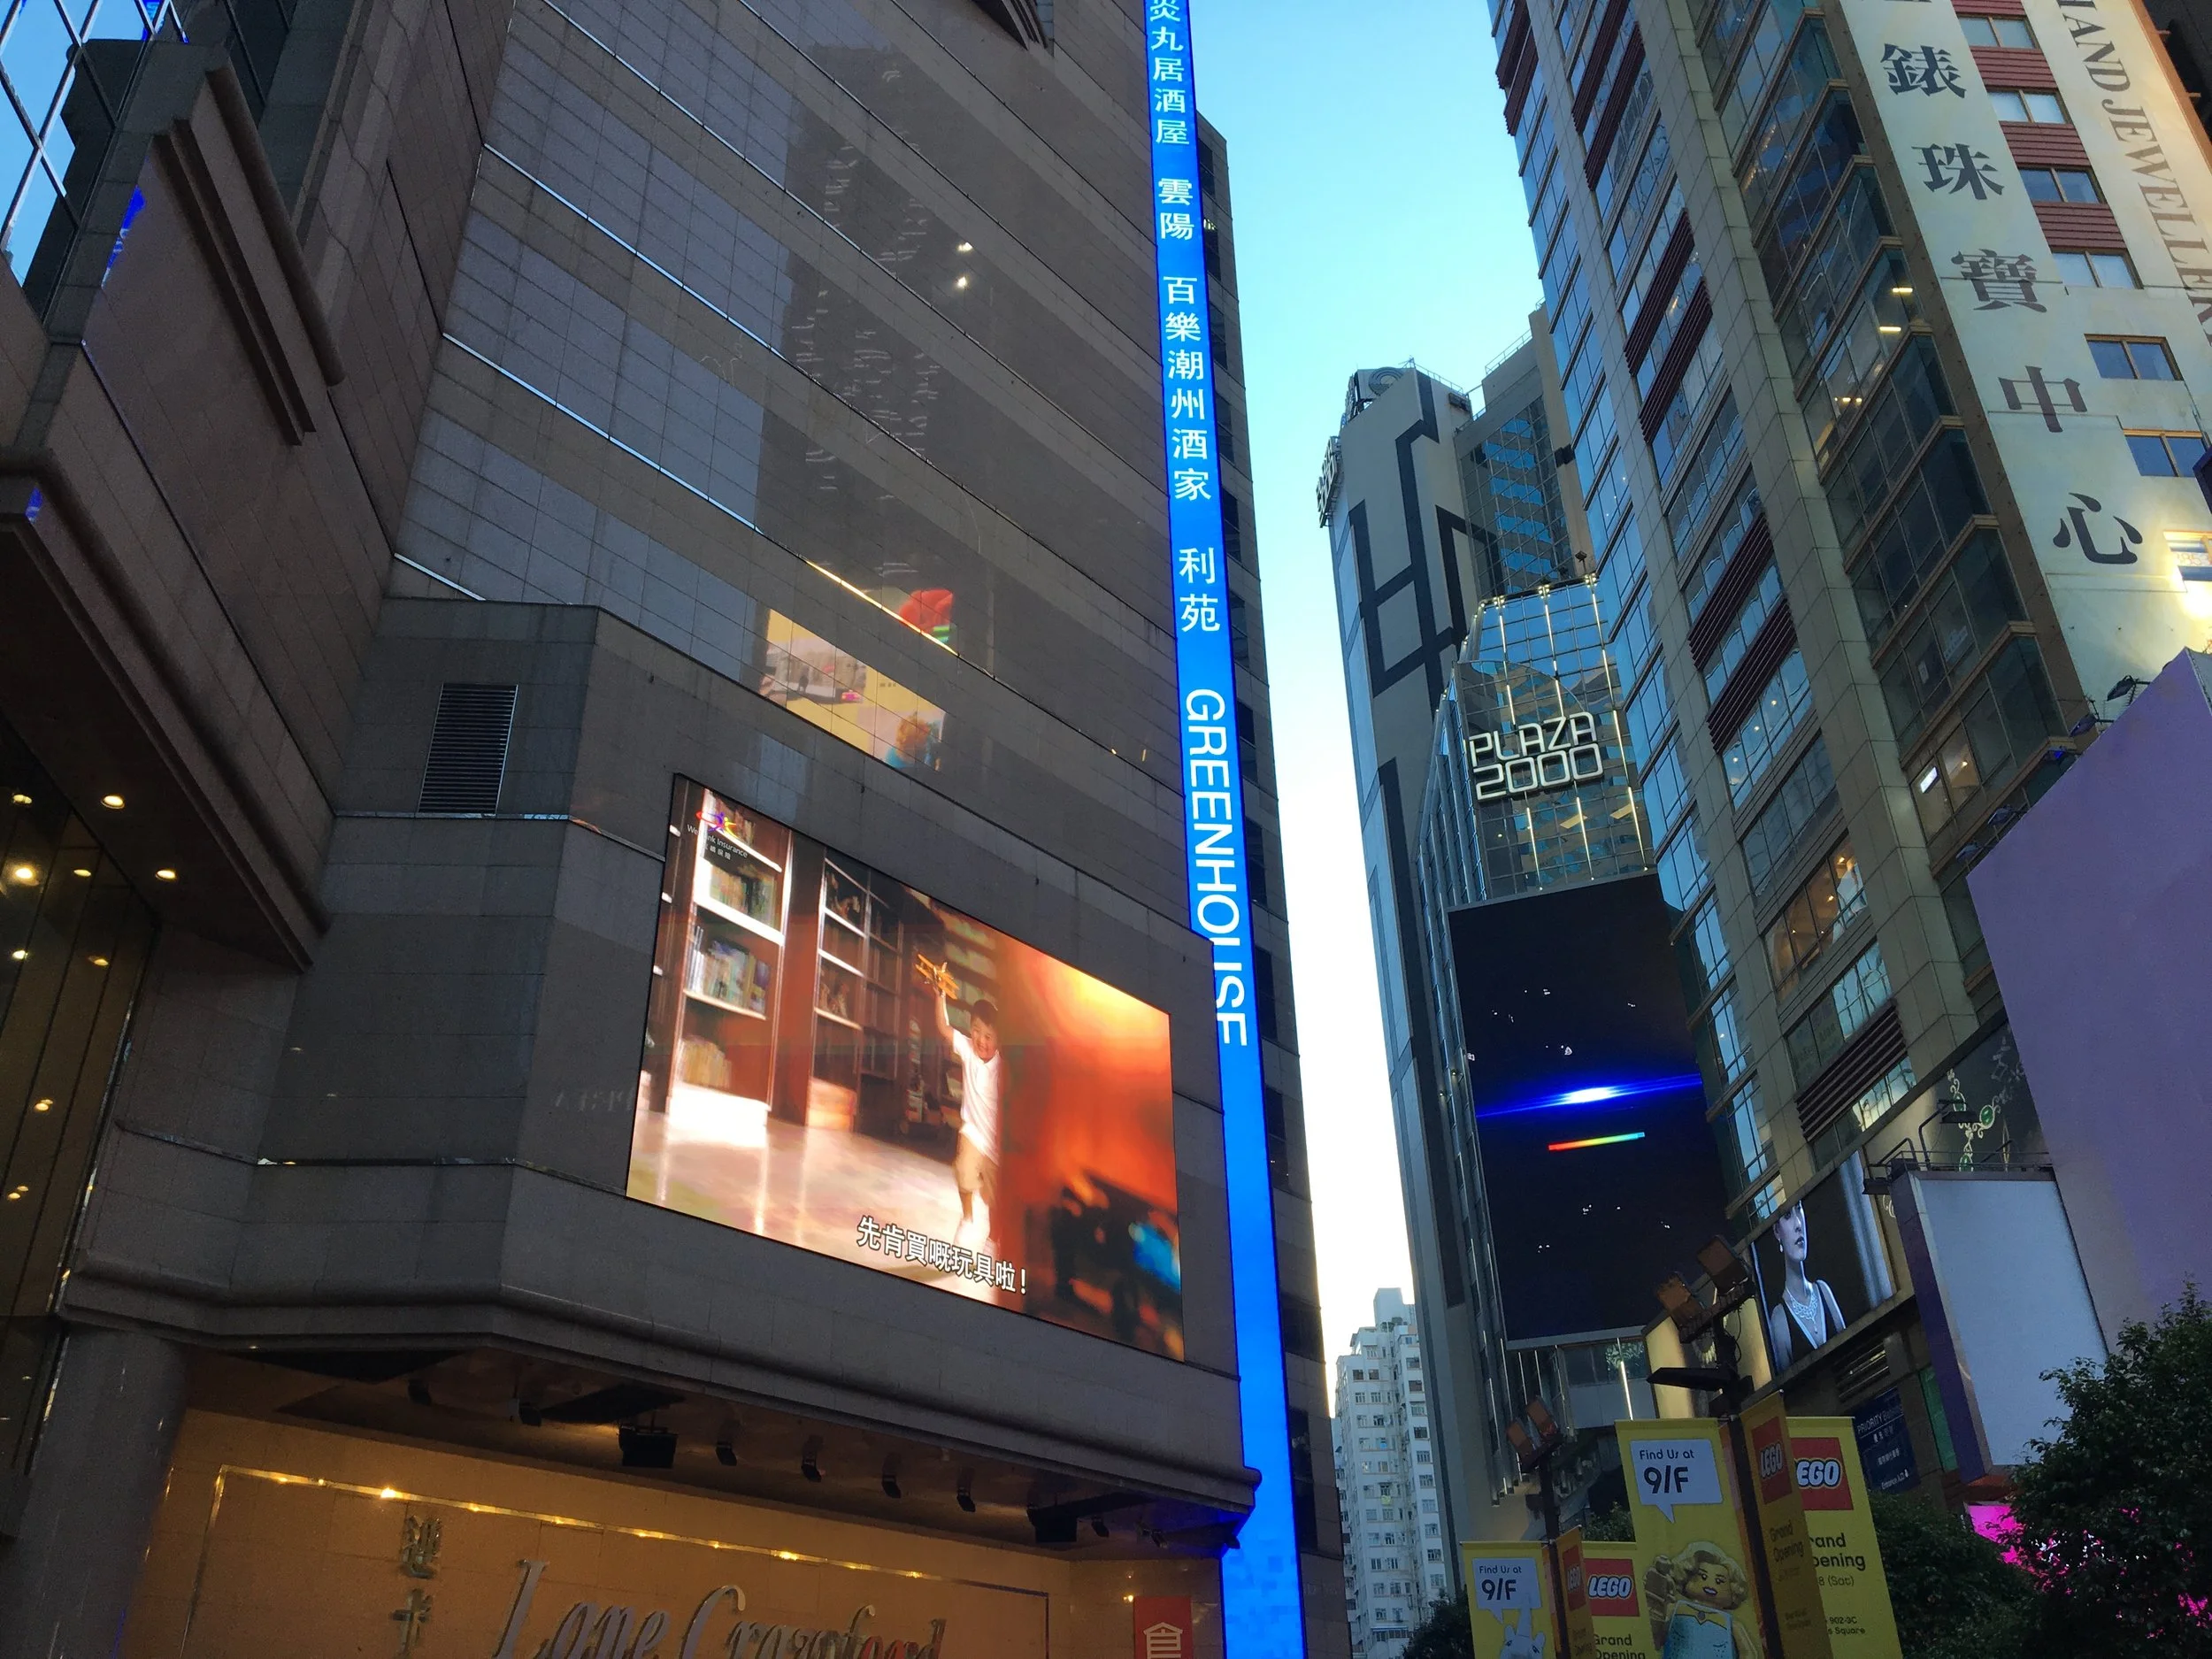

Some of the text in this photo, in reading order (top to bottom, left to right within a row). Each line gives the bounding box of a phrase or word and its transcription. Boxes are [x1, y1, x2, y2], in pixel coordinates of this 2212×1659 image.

[1149, 0, 1189, 145] 炎丸居酒屋
[2062, 12, 2131, 92] AND
[2101, 98, 2212, 348] JEWELLER
[1157, 177, 1194, 241] 雲陽
[1880, 42, 2143, 565] 錶珠寶中心
[1163, 274, 1212, 502] 百樂潮州酒家
[1178, 546, 1221, 634] 利苑
[1469, 711, 1597, 767] PLAZA
[1472, 742, 1603, 800] 2000
[717, 838, 749, 859] Insurance
[1640, 1449, 1694, 1460] Find Us at
[1760, 1443, 1783, 1478] LEGO
[1643, 1465, 1689, 1494] 9/F
[1796, 1459, 1840, 1486] EGO
[1479, 1564, 1522, 1575] Find Us at
[1813, 1553, 1866, 1571] pening
[1480, 1578, 1517, 1601] 9/F
[1587, 1575, 1632, 1598] LEGO
[1828, 1575, 1855, 1586] (Sat)
[1834, 1626, 1866, 1636] Square
